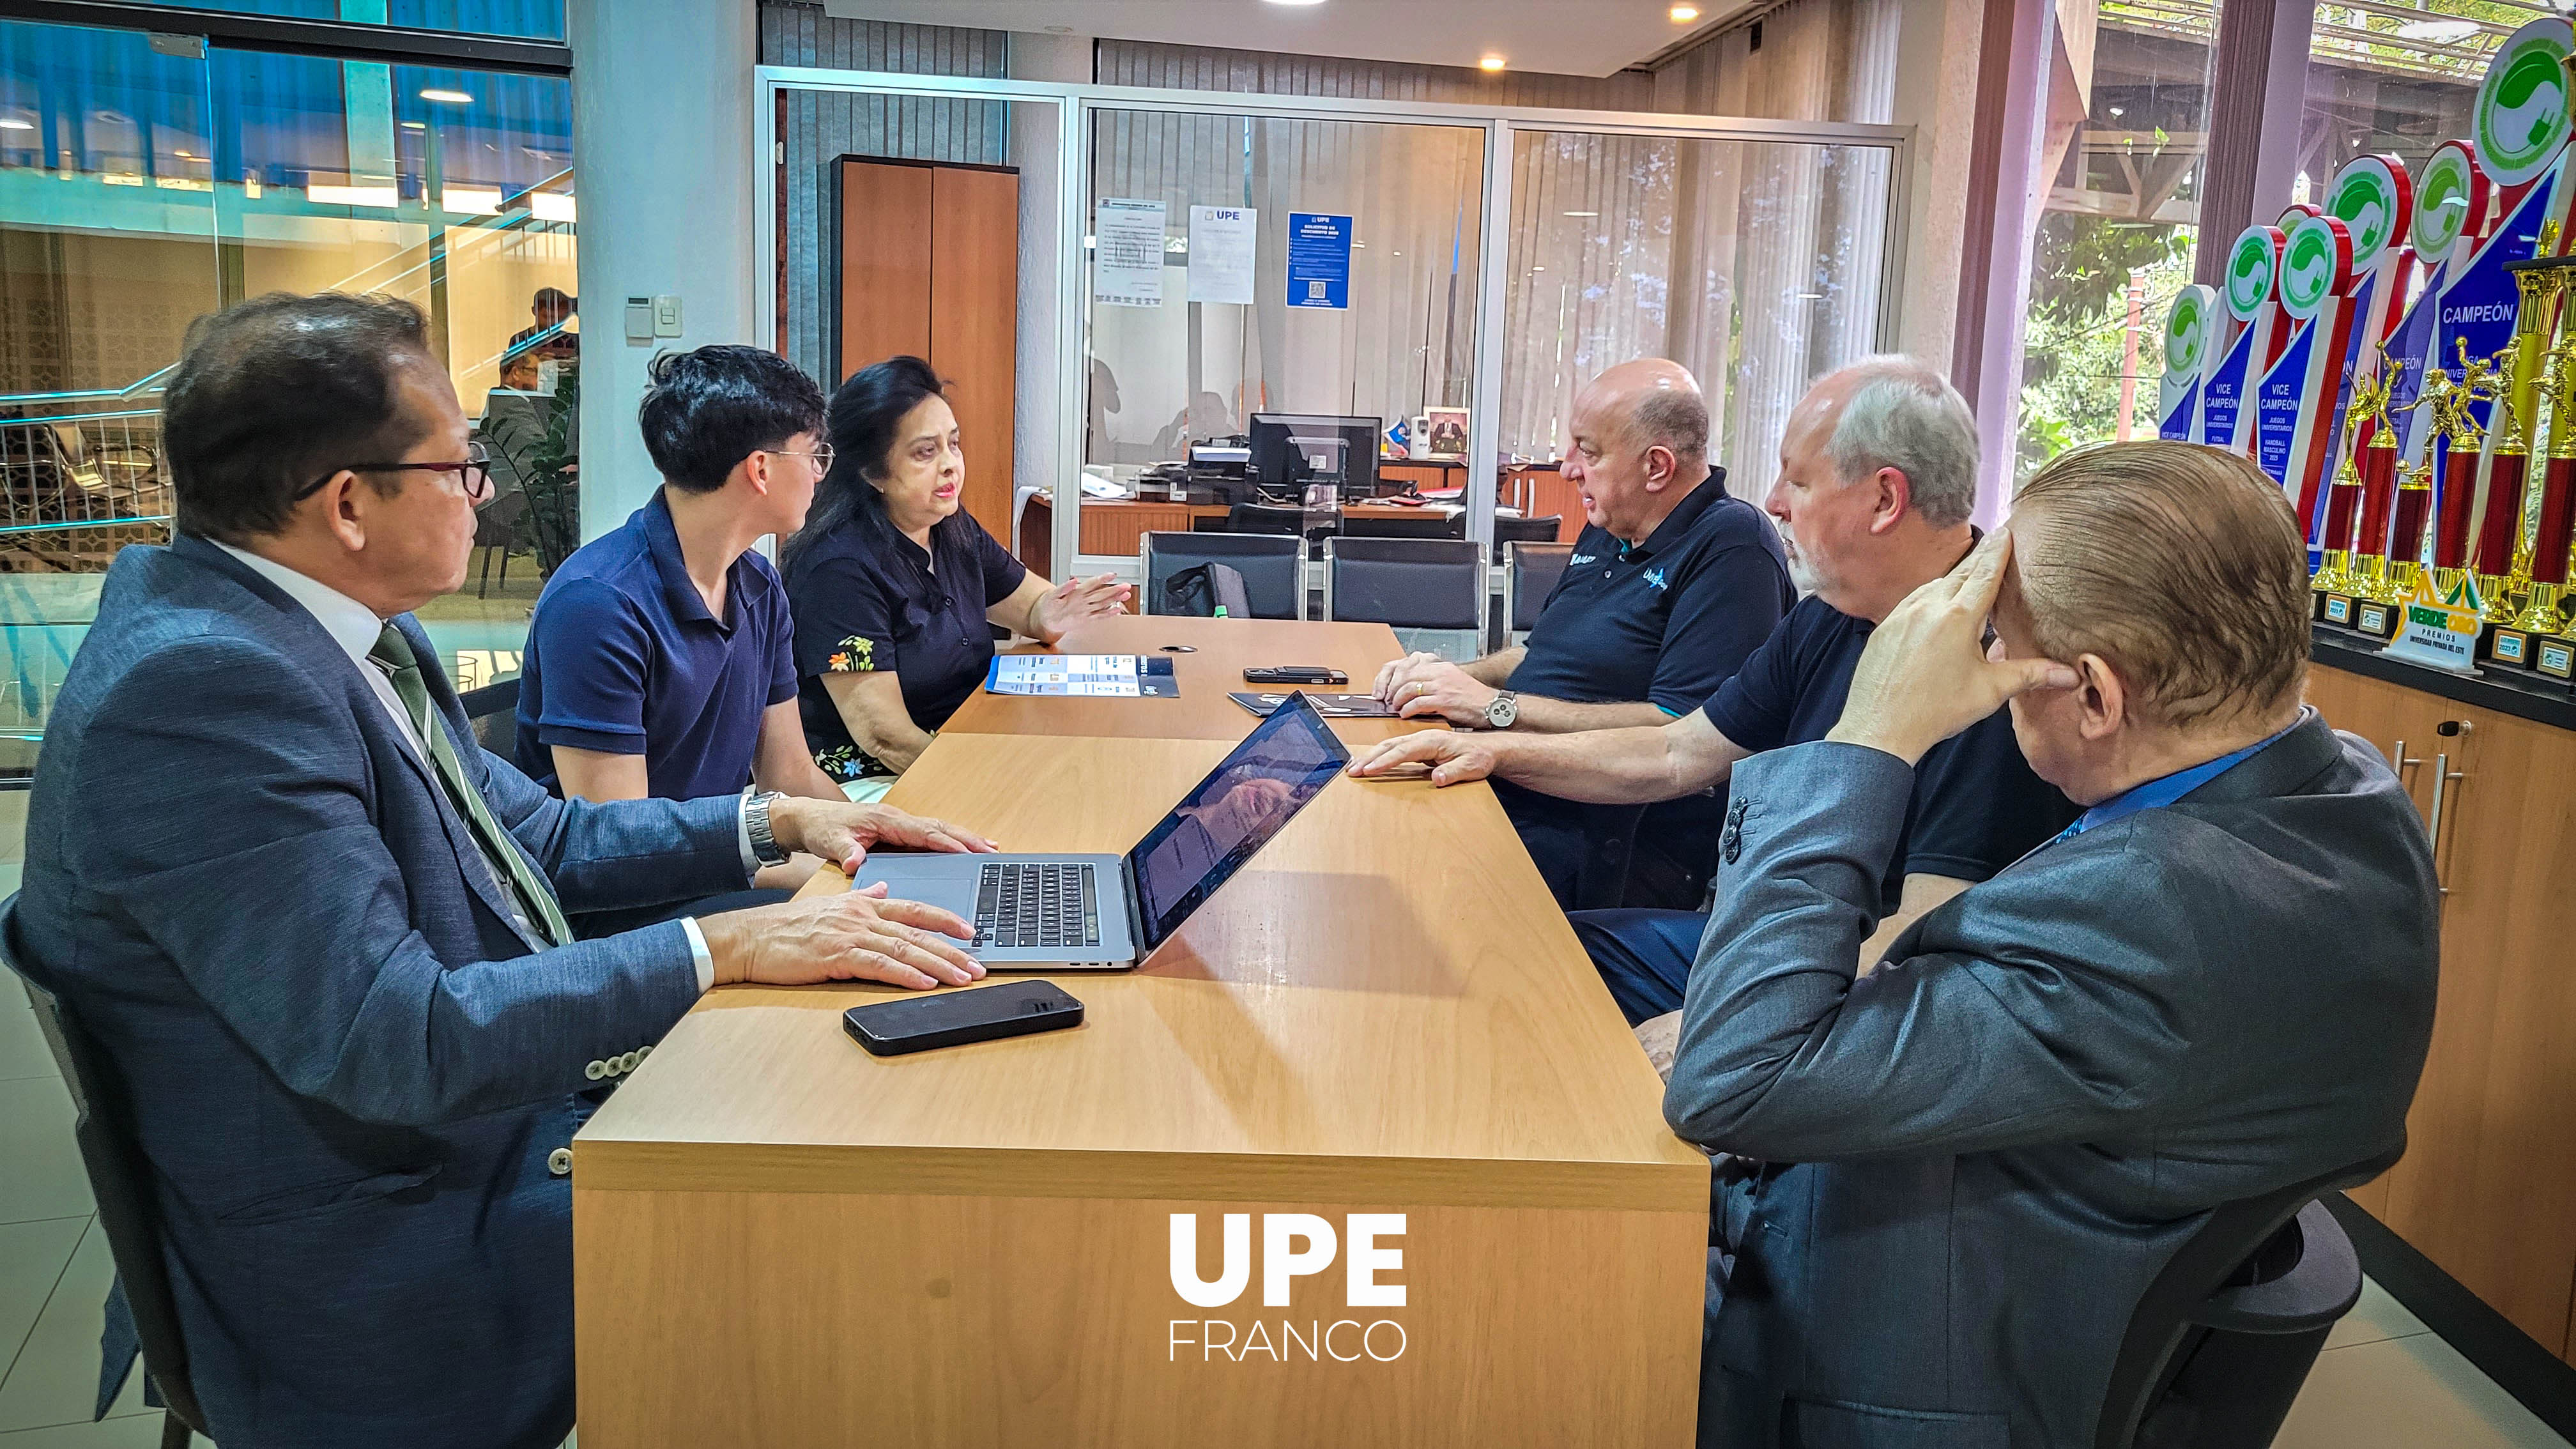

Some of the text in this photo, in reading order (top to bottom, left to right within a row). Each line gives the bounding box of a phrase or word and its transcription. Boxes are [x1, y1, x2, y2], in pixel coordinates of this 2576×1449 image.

[1216, 210, 1240, 220] UPE
[2442, 300, 2514, 324] CAMPEÓN
[2384, 354, 2422, 370] CPEÓN
[2216, 383, 2232, 394] VICE
[2272, 384, 2290, 395] VICE
[2206, 394, 2239, 410] CAMPEÓN
[2260, 395, 2298, 411] CAMPEÓN
[2263, 446, 2286, 454] MASCULINO
[2408, 605, 2448, 630] VERDE
[2446, 613, 2478, 635] ORO
[2421, 628, 2456, 643] PREMIOS
[2409, 635, 2432, 647] UNIVERSIDAD
[2432, 640, 2448, 650] PRIVADA
[2455, 646, 2465, 655] ESTE
[2499, 643, 2511, 652] 2023
